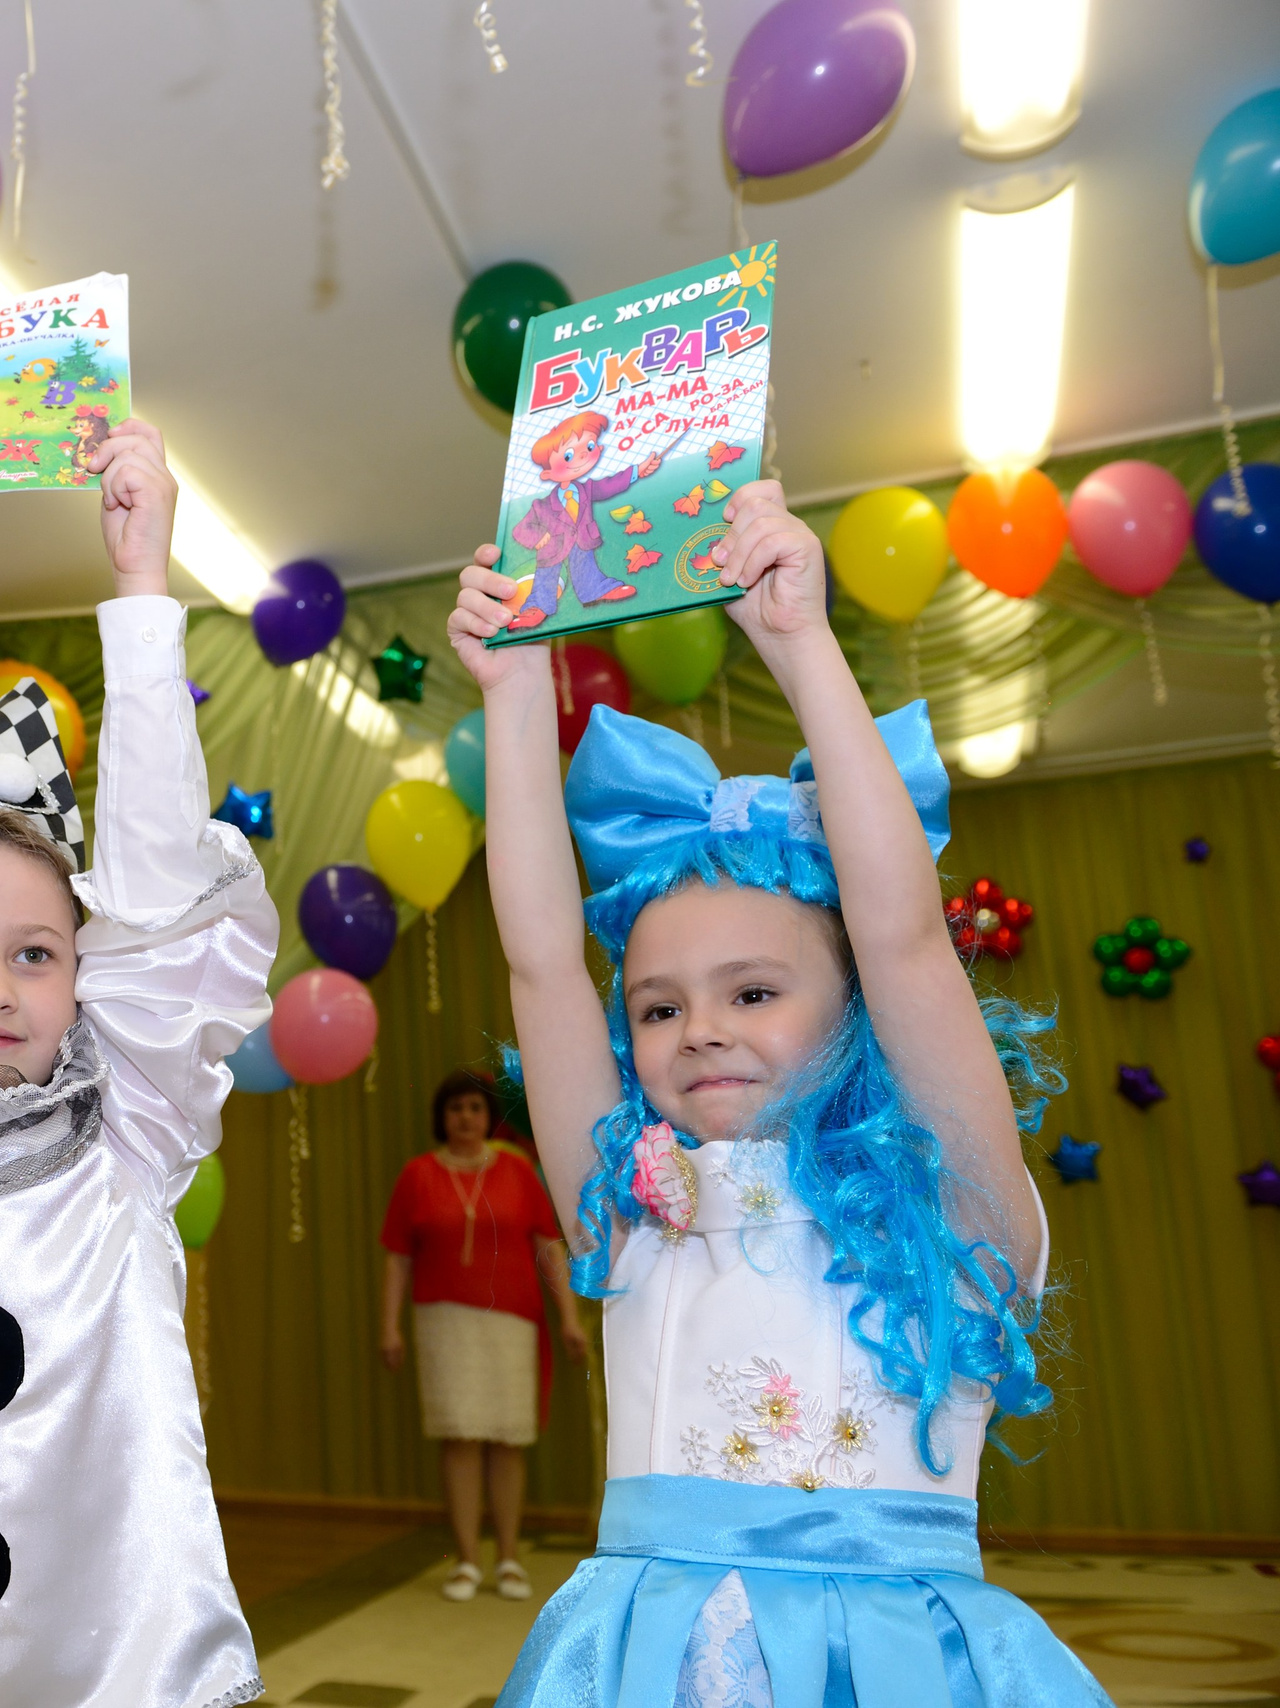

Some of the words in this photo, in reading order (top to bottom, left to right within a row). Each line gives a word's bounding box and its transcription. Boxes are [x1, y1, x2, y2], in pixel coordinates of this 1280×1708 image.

[613, 269, 743, 324] ЖУКОВА
[614, 375, 709, 416] МА-МА
[689, 378, 745, 412] РО-ЗА
[709, 379, 764, 414] БА-РА-БАН
[613, 416, 637, 433] АУ
[617, 411, 671, 452] О-СА
[664, 413, 730, 434] ЛУ-НА
